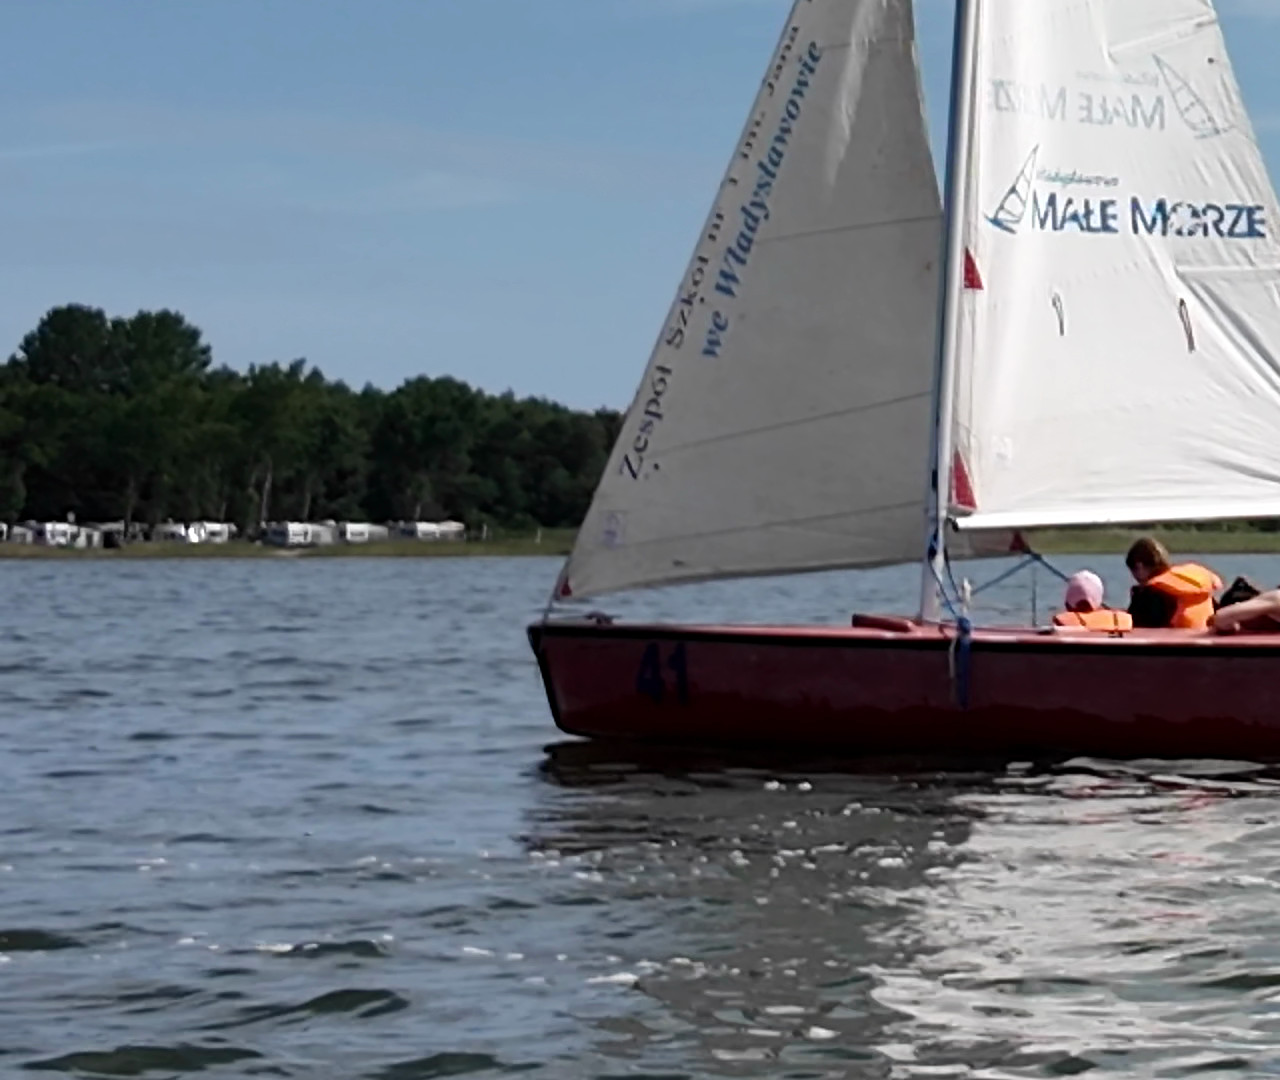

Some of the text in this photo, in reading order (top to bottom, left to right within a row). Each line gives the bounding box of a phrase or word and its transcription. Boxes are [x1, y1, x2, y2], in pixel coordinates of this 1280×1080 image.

[701, 40, 823, 359] we Władysławowie
[1032, 190, 1266, 239] MAŁE MORZE
